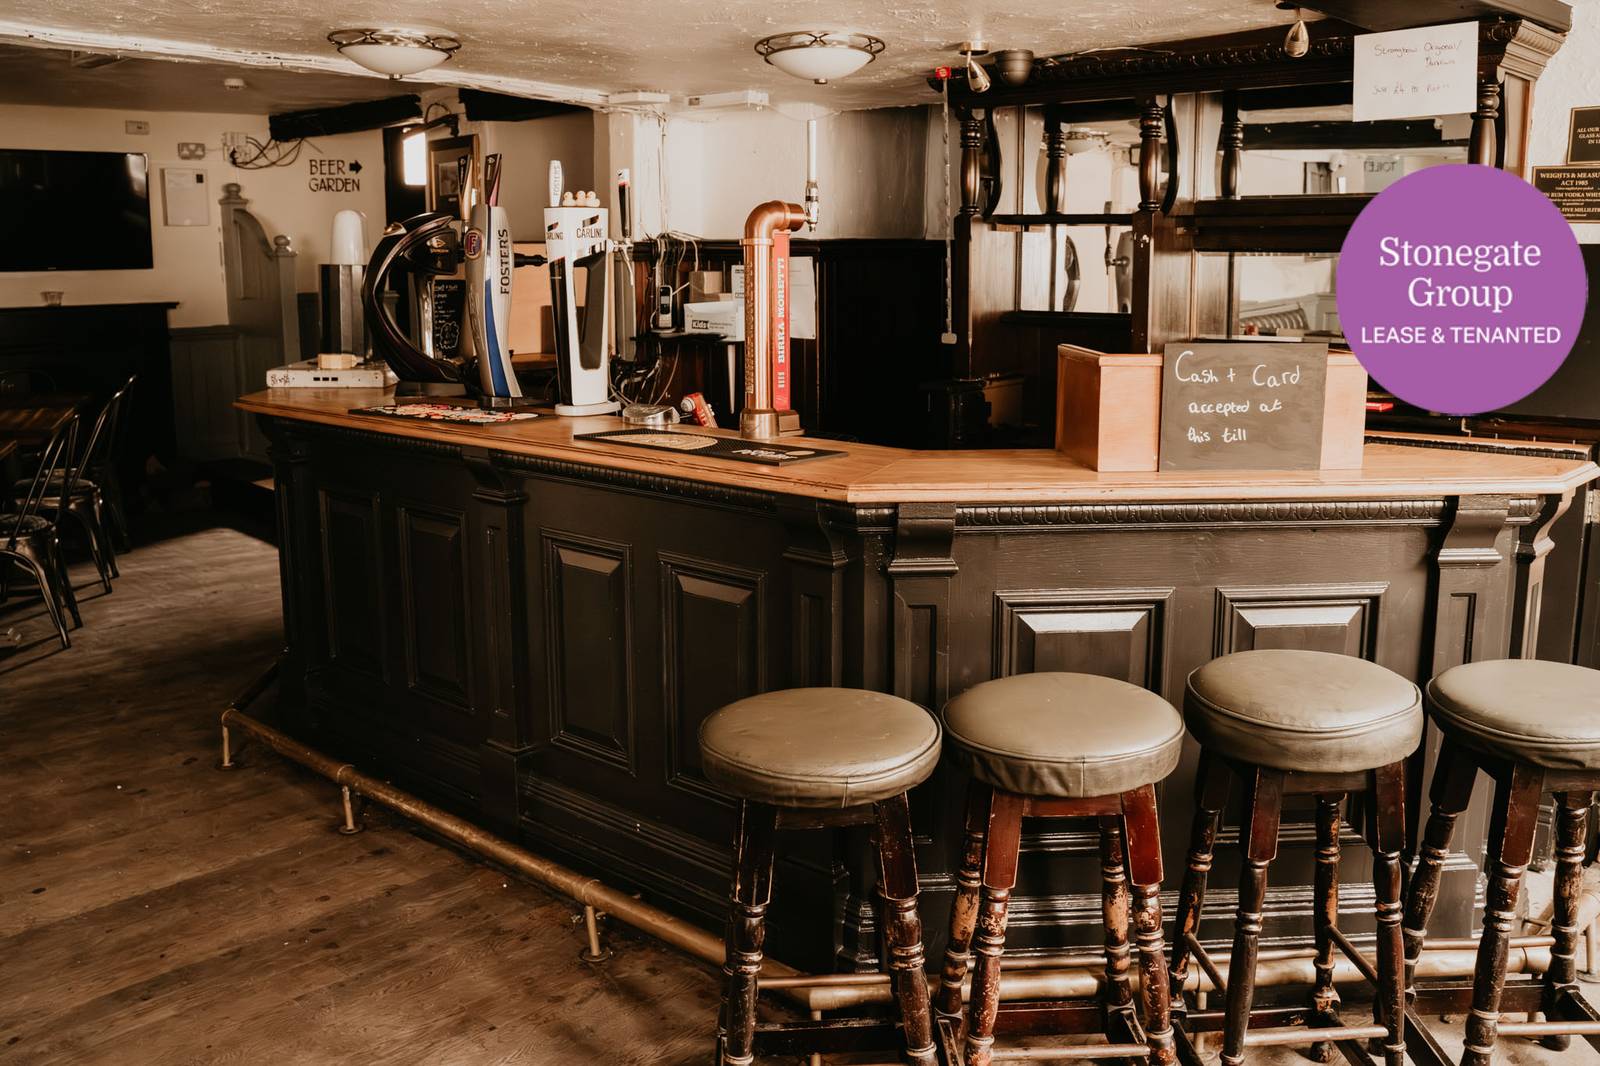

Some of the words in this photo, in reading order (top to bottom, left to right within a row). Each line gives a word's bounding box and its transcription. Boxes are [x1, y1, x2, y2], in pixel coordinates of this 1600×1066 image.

[309, 159, 346, 176] BEER
[308, 177, 361, 192] GARDEN
[498, 228, 510, 295] FOSTER'S
[1175, 350, 1219, 383] Cash
[1227, 367, 1236, 383] +
[1252, 364, 1301, 388] Card
[1188, 399, 1250, 417] accepted
[1259, 399, 1283, 413] at
[1187, 426, 1211, 443] this
[1221, 427, 1247, 443] till
